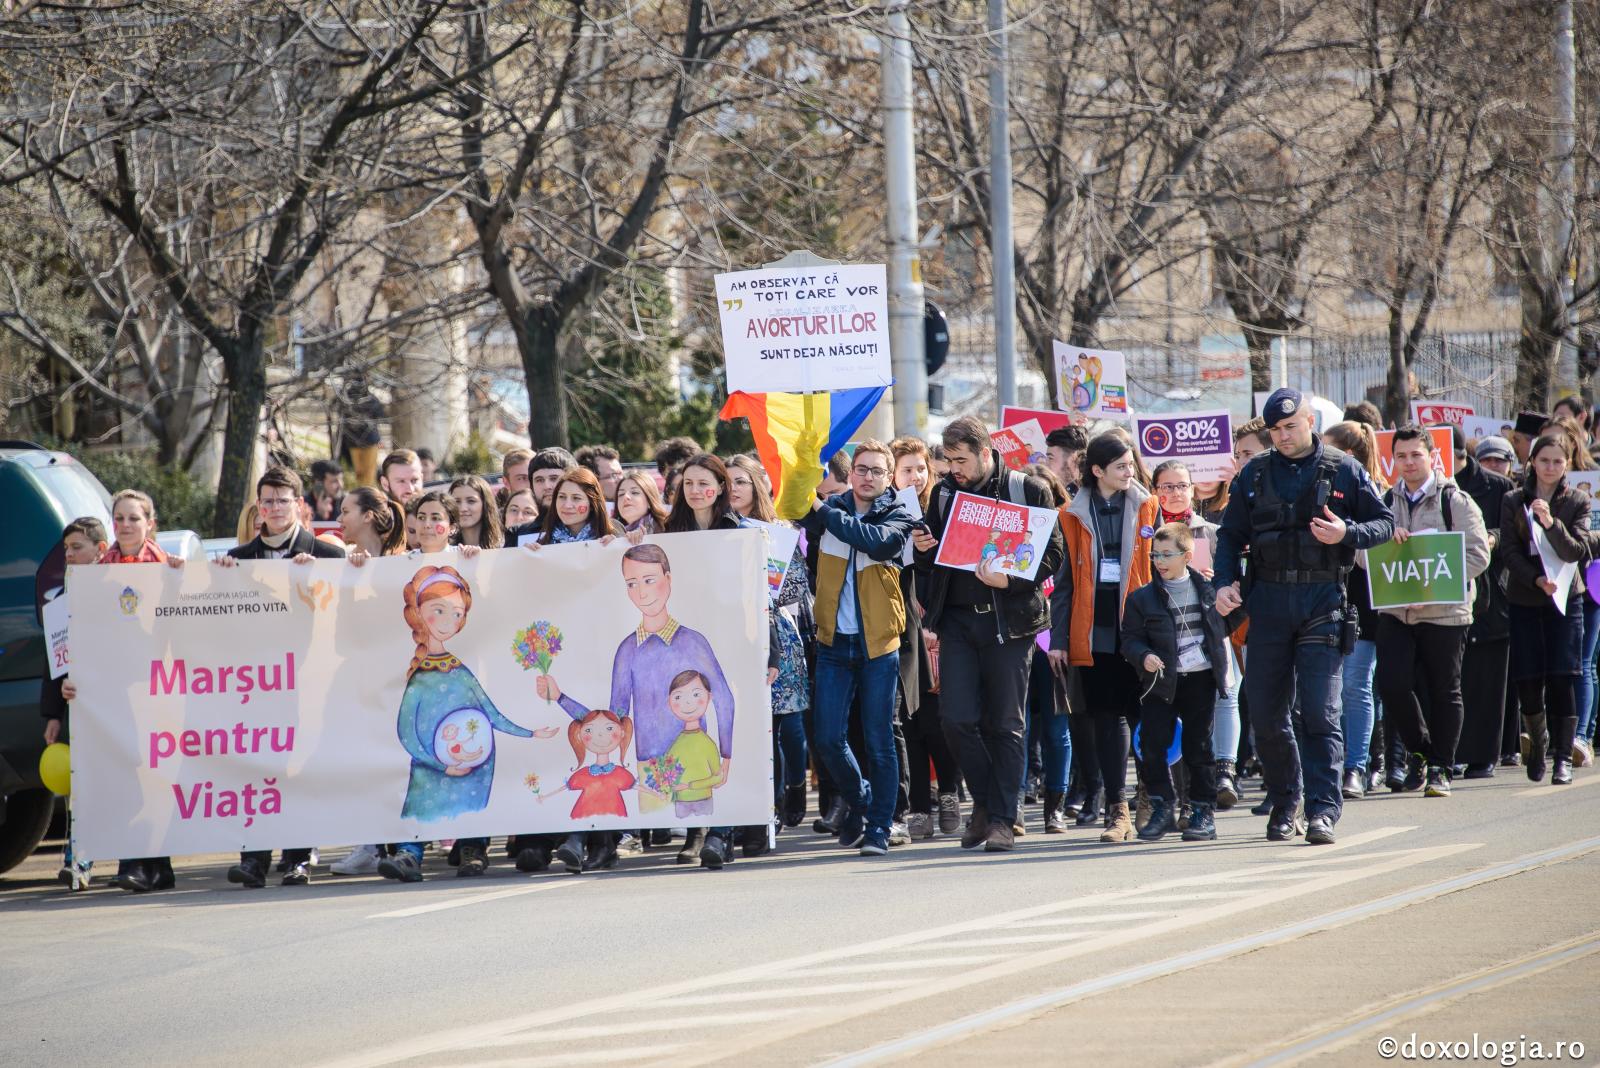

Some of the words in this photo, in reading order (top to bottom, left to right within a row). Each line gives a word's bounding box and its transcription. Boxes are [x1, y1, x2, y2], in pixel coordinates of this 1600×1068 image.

[731, 281, 747, 292] AM
[750, 276, 816, 289] OBSERVAT
[824, 272, 839, 285] CĂ
[754, 291, 788, 303] TOȚI
[796, 288, 836, 300] CARE
[846, 285, 878, 296] VOR
[746, 312, 877, 338] AVORTURILOR
[760, 349, 791, 360] SUNT
[793, 347, 826, 359] DEJA
[829, 343, 878, 357] NĂSCUȚI
[1175, 418, 1219, 440] 80%
[960, 507, 994, 521] PENTRU
[962, 500, 995, 514] PENTRU
[958, 513, 992, 528] PENTRU
[1381, 552, 1453, 587] VIAȚĂ
[155, 604, 234, 617] DEPARTAMENT
[237, 603, 261, 614] PRO
[263, 602, 288, 613] VITA
[150, 652, 295, 704] Marșul
[150, 722, 295, 768] pentru
[172, 777, 282, 828] Viață
